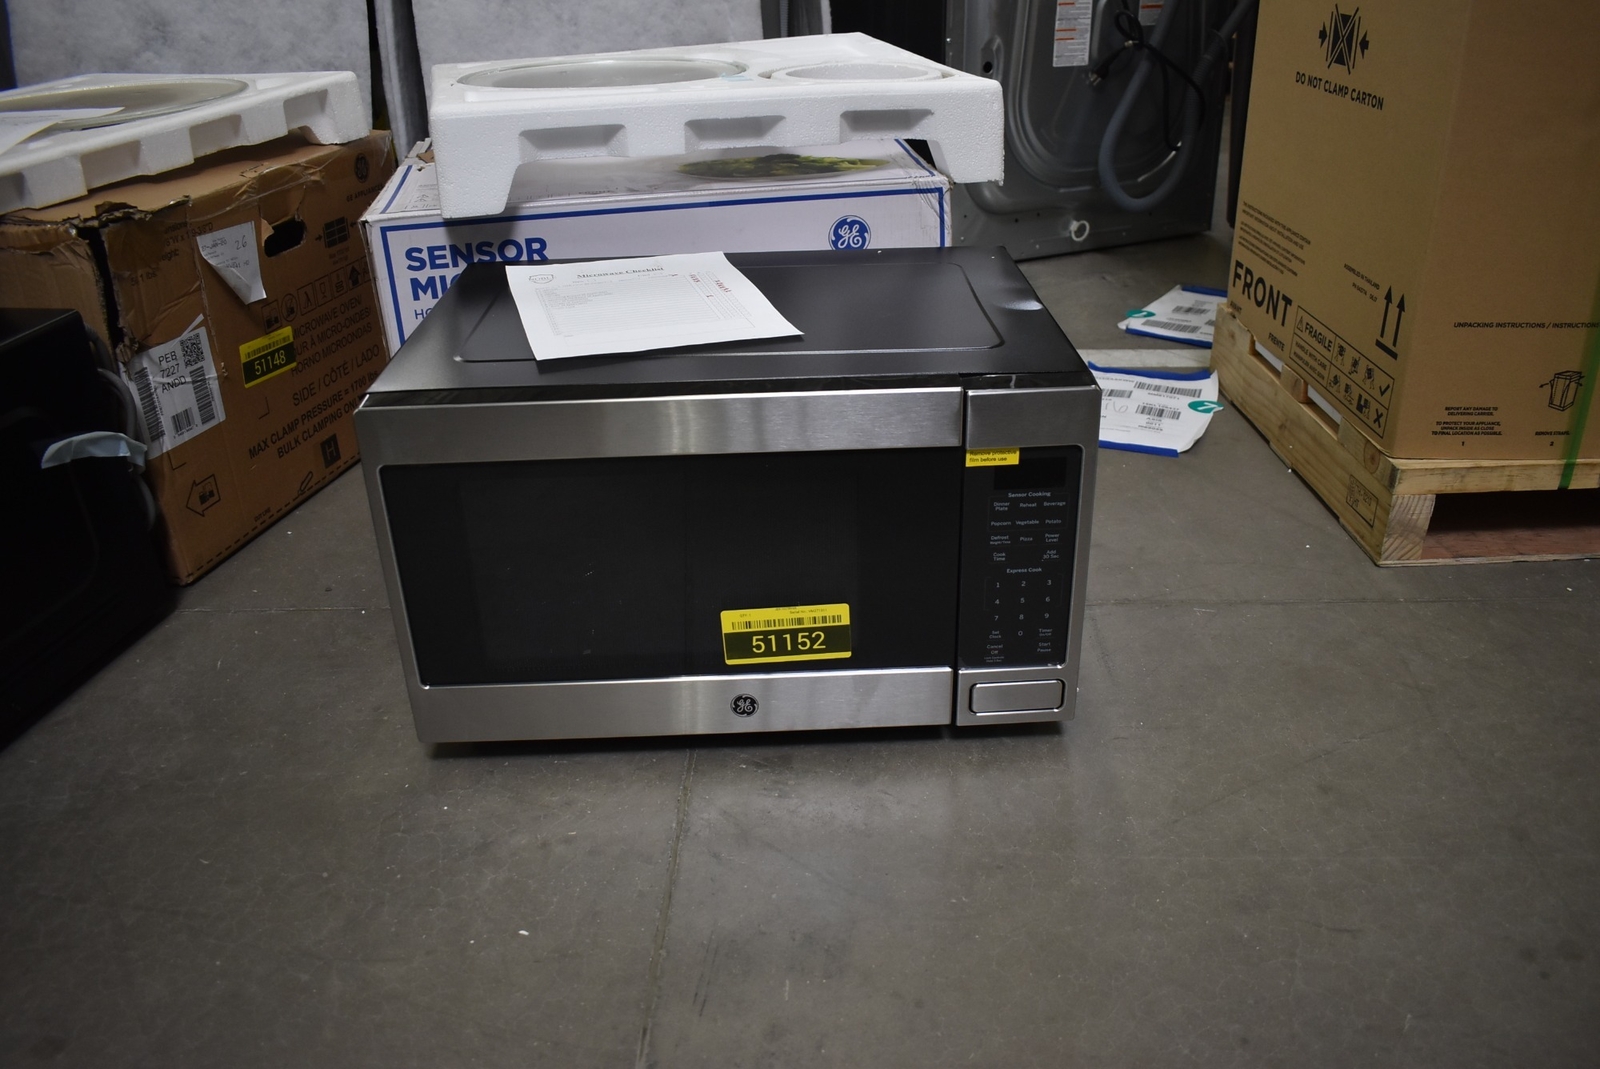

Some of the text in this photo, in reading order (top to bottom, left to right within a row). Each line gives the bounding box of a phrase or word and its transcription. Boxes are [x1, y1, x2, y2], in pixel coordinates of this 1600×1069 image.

[1296, 72, 1384, 110] DO NOT CLAMP CARTON
[235, 235, 247, 250] 26
[405, 238, 549, 272] SENSOR
[1233, 260, 1292, 327] FRONT
[291, 322, 372, 377] HORNO MICROONDAS
[1268, 332, 1285, 352] FRENTE
[1305, 322, 1333, 353] FRAGILE
[158, 351, 177, 365] PEB
[160, 363, 180, 378] 7227
[255, 350, 286, 375] 51148
[1318, 359, 1327, 371] CARE
[162, 376, 186, 393] ANDD
[292, 382, 318, 406] SIDE
[323, 360, 350, 387] CÔTÉ
[355, 344, 379, 368] LADO
[248, 438, 270, 459] MAX
[270, 419, 300, 445] CLAMP
[301, 390, 343, 426] PRESSURE
[351, 378, 366, 394] 1700
[368, 371, 378, 382] lbs
[277, 435, 301, 459] BULK
[302, 408, 343, 442] CLAMPING
[752, 631, 826, 653] 51152
